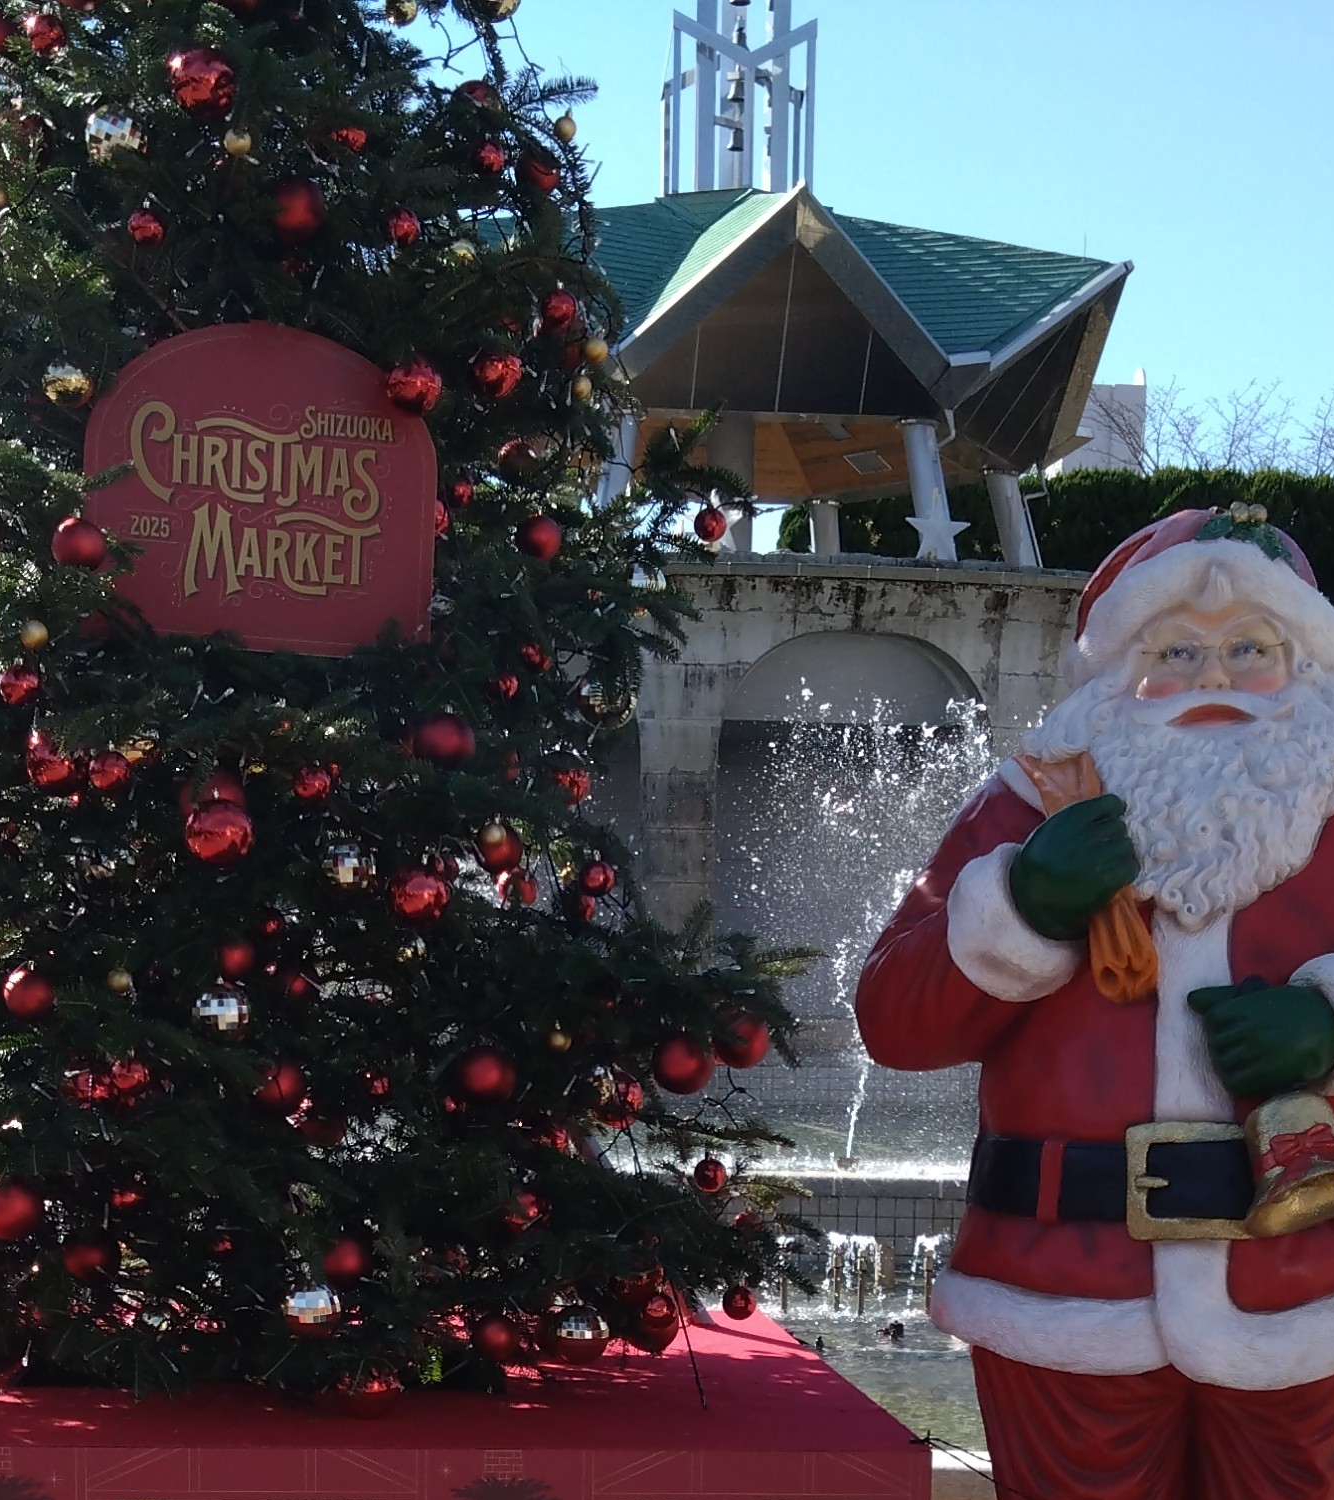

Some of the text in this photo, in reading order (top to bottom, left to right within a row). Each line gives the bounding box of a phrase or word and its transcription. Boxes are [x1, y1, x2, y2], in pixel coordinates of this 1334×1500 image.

[300, 405, 394, 441] SHIZUOKA
[130, 401, 380, 522] CHRISTMAS
[130, 514, 170, 538] 2025
[183, 503, 381, 597] MARKET
